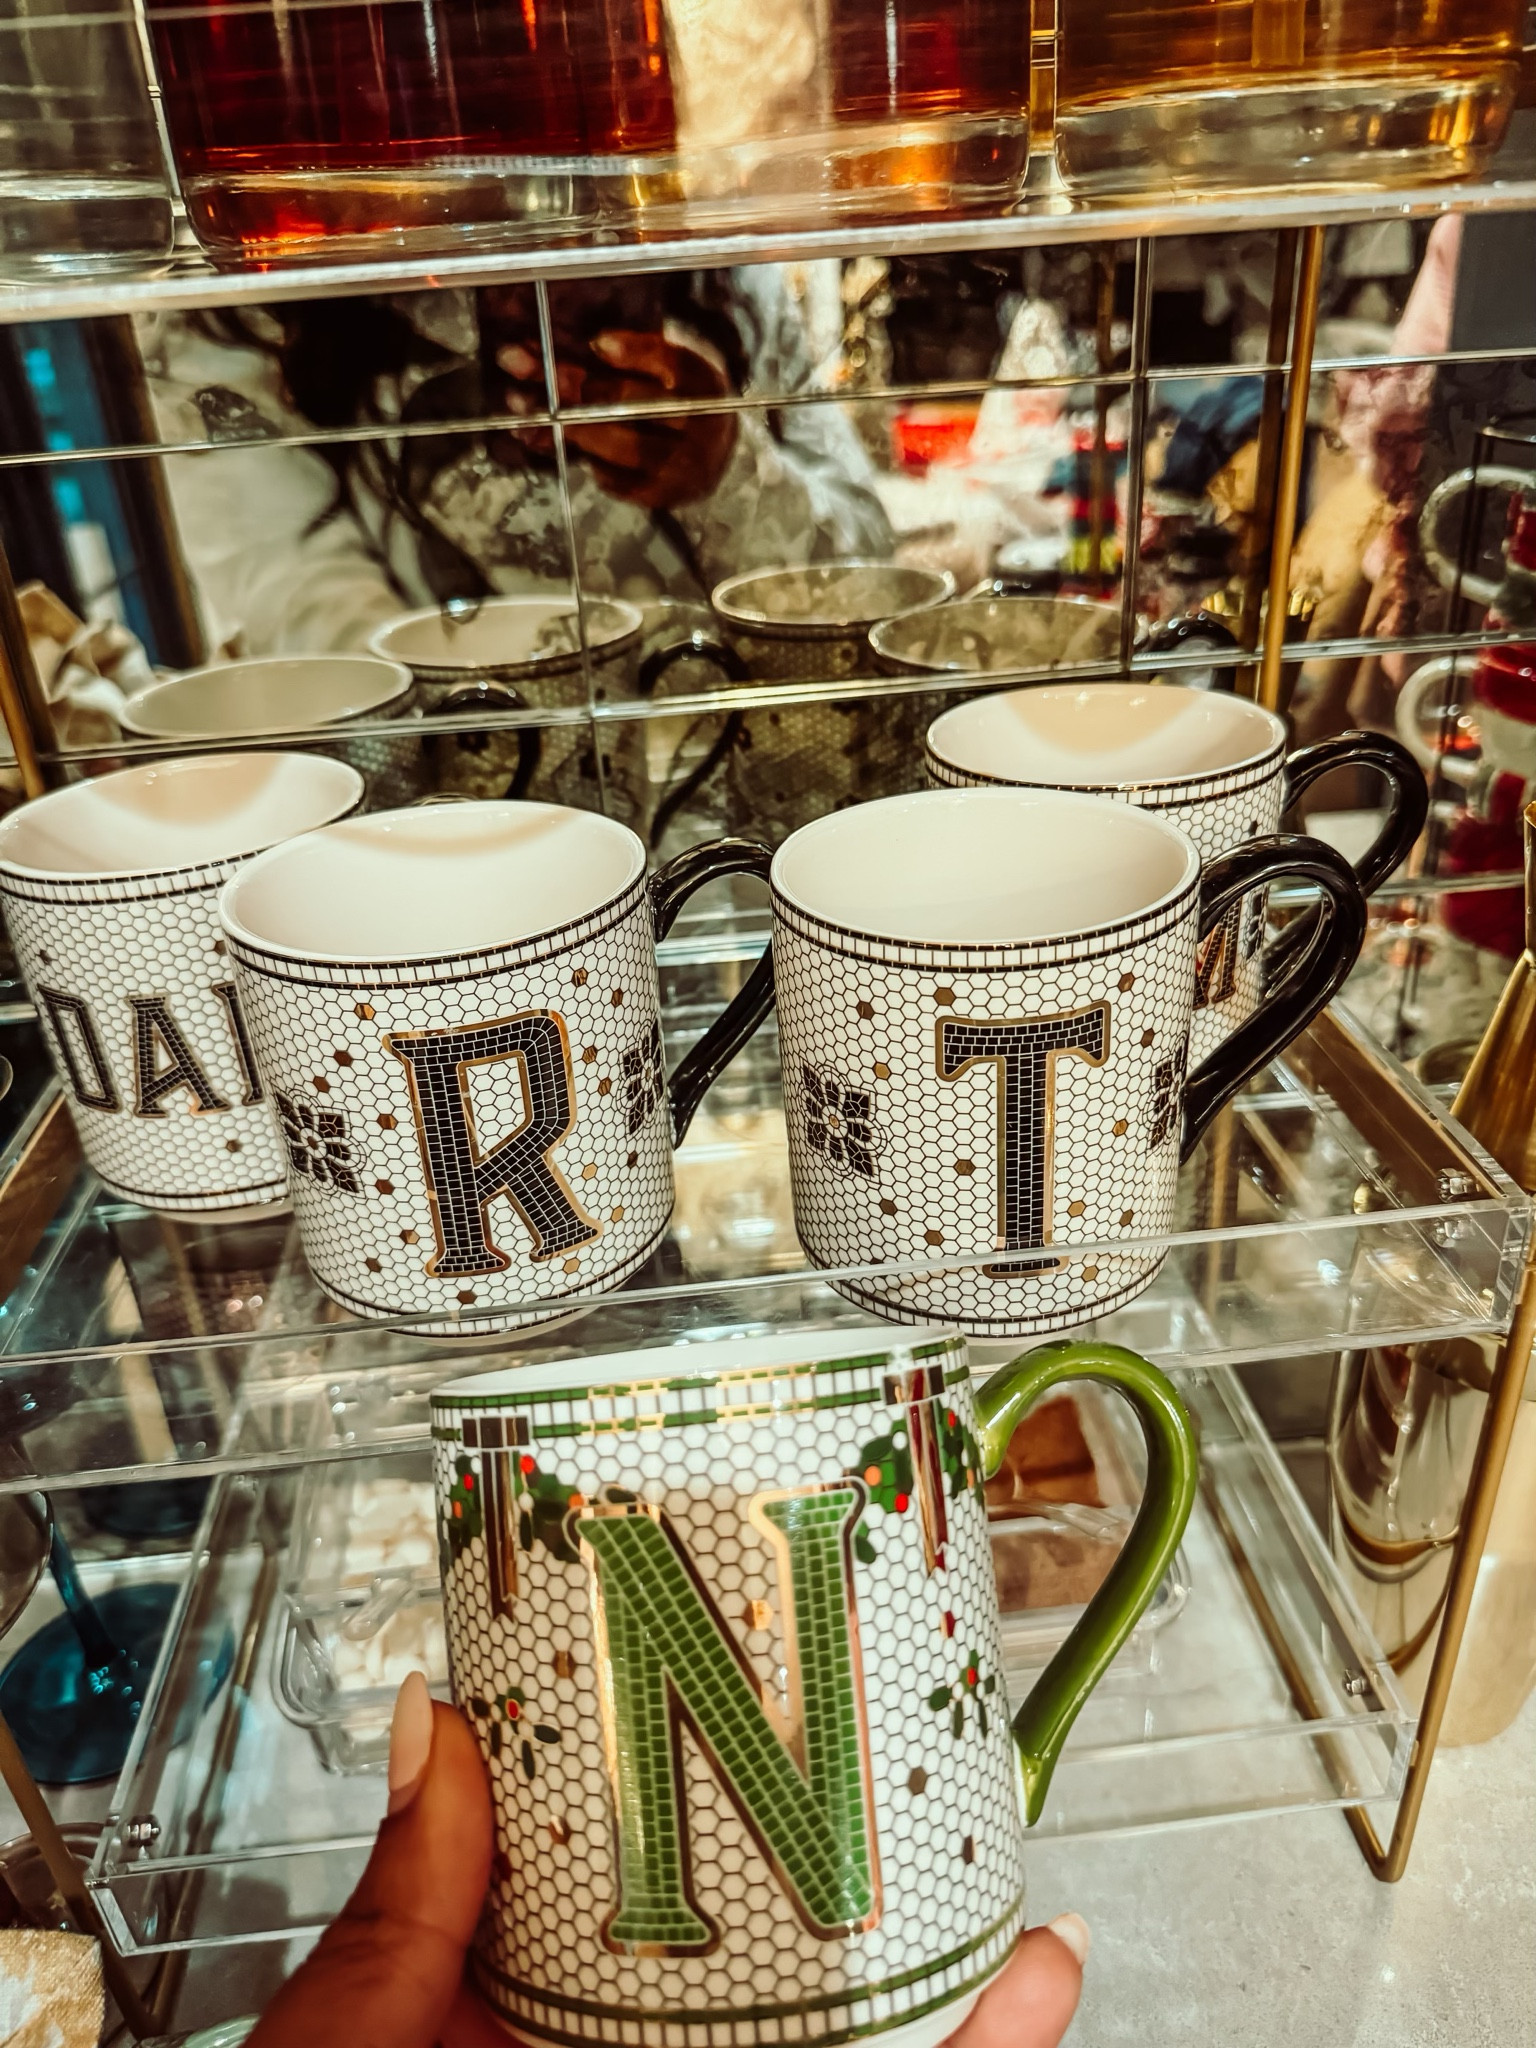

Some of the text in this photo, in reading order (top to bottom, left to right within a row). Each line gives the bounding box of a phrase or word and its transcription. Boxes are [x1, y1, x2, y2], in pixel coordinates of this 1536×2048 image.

[382, 1009, 604, 1278] R
[935, 1000, 1111, 1279] T
[562, 1476, 883, 1958] N
